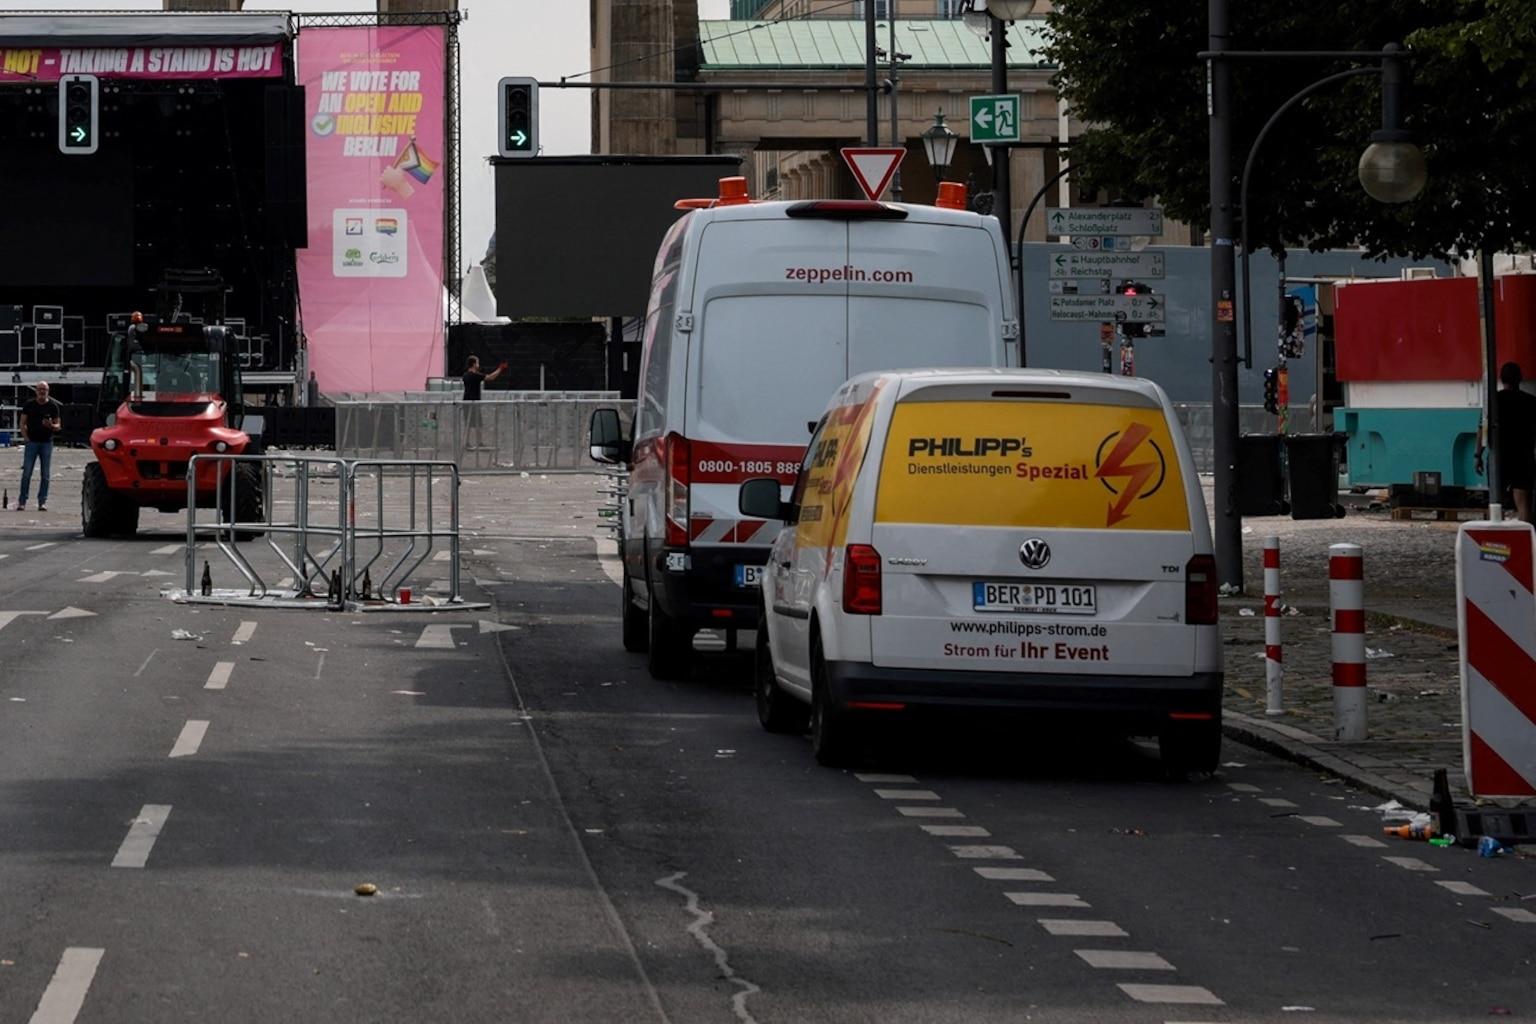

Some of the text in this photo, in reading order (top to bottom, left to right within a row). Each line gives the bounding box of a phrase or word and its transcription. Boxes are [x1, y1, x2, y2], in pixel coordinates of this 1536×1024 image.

[3, 49, 42, 74] HOT
[59, 49, 128, 73] TAKING
[130, 48, 144, 72] A
[147, 48, 212, 73] STAND
[213, 48, 234, 72] IS
[236, 47, 275, 71] HOT
[322, 71, 421, 92] WE VOTE FOR
[318, 92, 423, 113] AN OPEN AND
[335, 114, 417, 135] INCLUSIVE
[344, 136, 398, 157] BERLIN
[1069, 212, 1132, 222] Alexanderplatz
[1069, 224, 1118, 234] Schloßplatz
[1081, 255, 1140, 266] Hauptbahnhof
[785, 265, 913, 284] zeppelin.com
[1070, 266, 1112, 277] Reichstag
[1061, 298, 1096, 307] Potsdamer
[1098, 298, 1115, 307] Platz
[908, 437, 1033, 458] PHILIPP's
[698, 460, 772, 474] 0800-1805
[908, 462, 1088, 482] Dienstleistungen Spezial
[888, 556, 928, 567] CADDY
[1161, 565, 1180, 574] TDI
[745, 567, 755, 583] B
[987, 585, 1094, 607] BER PD 101
[950, 621, 1107, 638] www.philipps-strom.de
[944, 642, 1110, 661] Strom für Ihr Event
